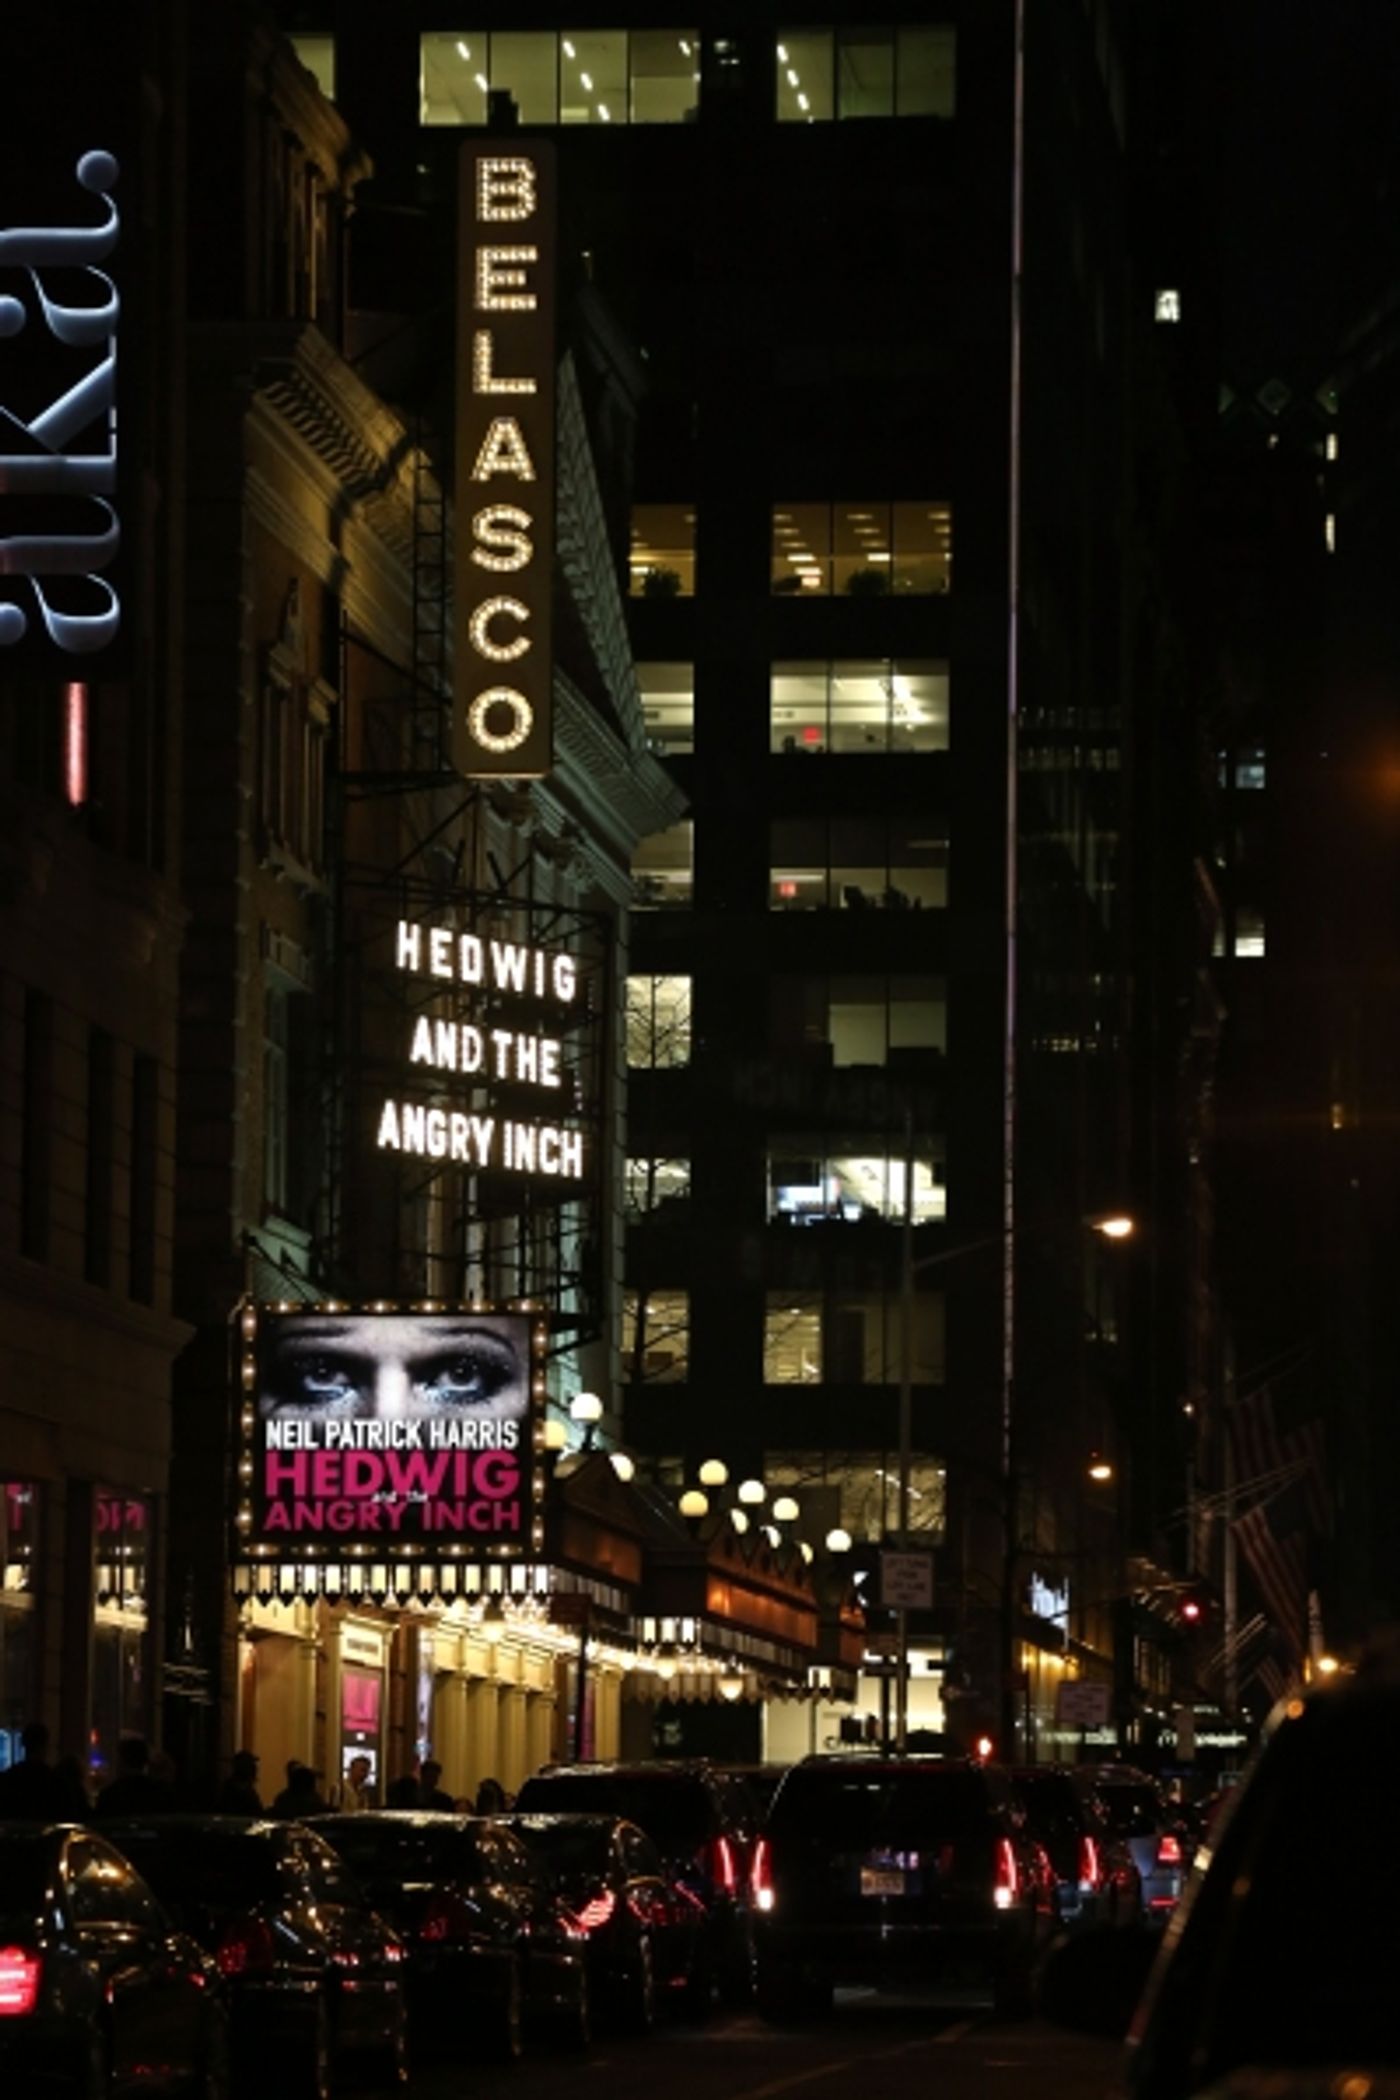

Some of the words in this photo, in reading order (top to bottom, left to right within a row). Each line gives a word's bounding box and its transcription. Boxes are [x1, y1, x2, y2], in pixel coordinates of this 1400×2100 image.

[466, 156, 538, 754] BELASCO
[396, 919, 577, 1003] HEDWIG
[409, 1014, 484, 1074] AND
[491, 1028, 562, 1088] THE
[377, 1099, 496, 1168] ANGRY
[502, 1120, 583, 1179] INCH
[265, 1420, 319, 1450] NEIL
[325, 1420, 422, 1450] PATRICK
[430, 1420, 519, 1450] HARRIS
[264, 1450, 520, 1498] HEDWIG
[263, 1501, 408, 1531] ANGRY
[423, 1501, 521, 1531] INCH
